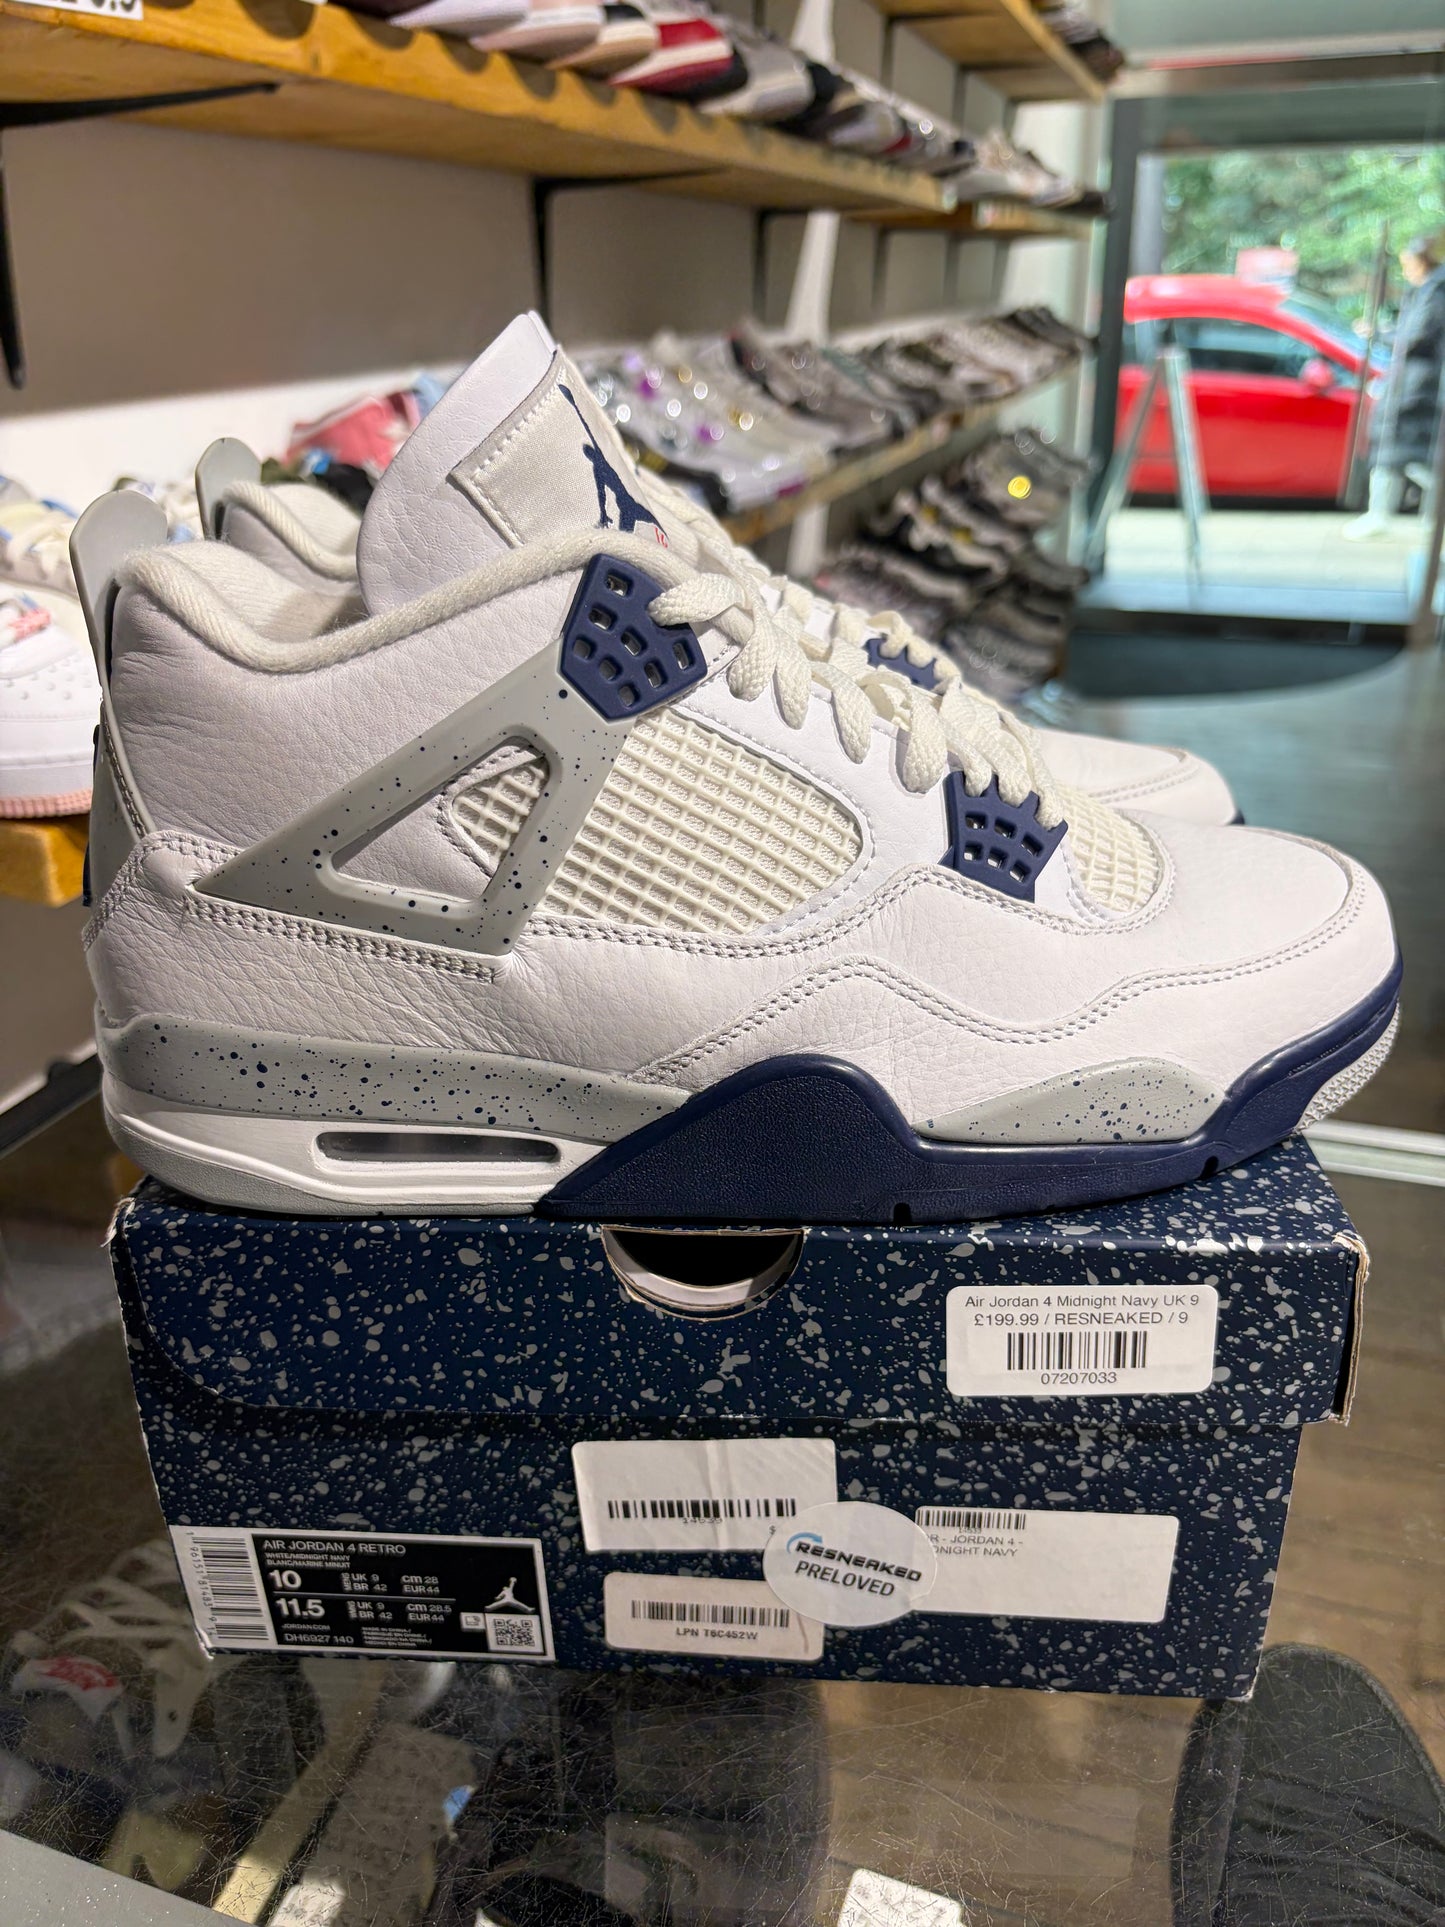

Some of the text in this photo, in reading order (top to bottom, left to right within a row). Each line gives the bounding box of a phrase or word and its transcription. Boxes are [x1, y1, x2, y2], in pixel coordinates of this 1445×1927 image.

[965, 1294, 1199, 1310] Air Jordan 4 Midnight Navy UK 9
[974, 1313, 1039, 1326] £199.99
[1054, 1311, 1163, 1325] RESNEAKED
[1178, 1311, 1189, 1324] 9
[1040, 1371, 1118, 1385] 07207033
[950, 1534, 1004, 1545] JORDAN
[1007, 1537, 1015, 1545] 4
[263, 1540, 406, 1555] AIR JORDAN 4 RETRO
[983, 1547, 1018, 1557] NAVY
[795, 1540, 923, 1582] RESNEAKED
[269, 1569, 302, 1589] 10
[351, 1573, 379, 1582] UK 9
[401, 1575, 439, 1584] cm 28
[795, 1560, 895, 1596] PRELOVED
[352, 1582, 388, 1592] BR 42
[403, 1584, 426, 1593] EUR
[276, 1597, 325, 1618] 11.5
[357, 1601, 385, 1610] UK 9
[406, 1603, 452, 1613] cm 28.5
[358, 1610, 374, 1619] BR
[408, 1612, 430, 1621] EUR
[284, 1633, 331, 1644] DH6927
[334, 1635, 354, 1645] 140
[676, 1627, 758, 1640] LPN T6C452W
